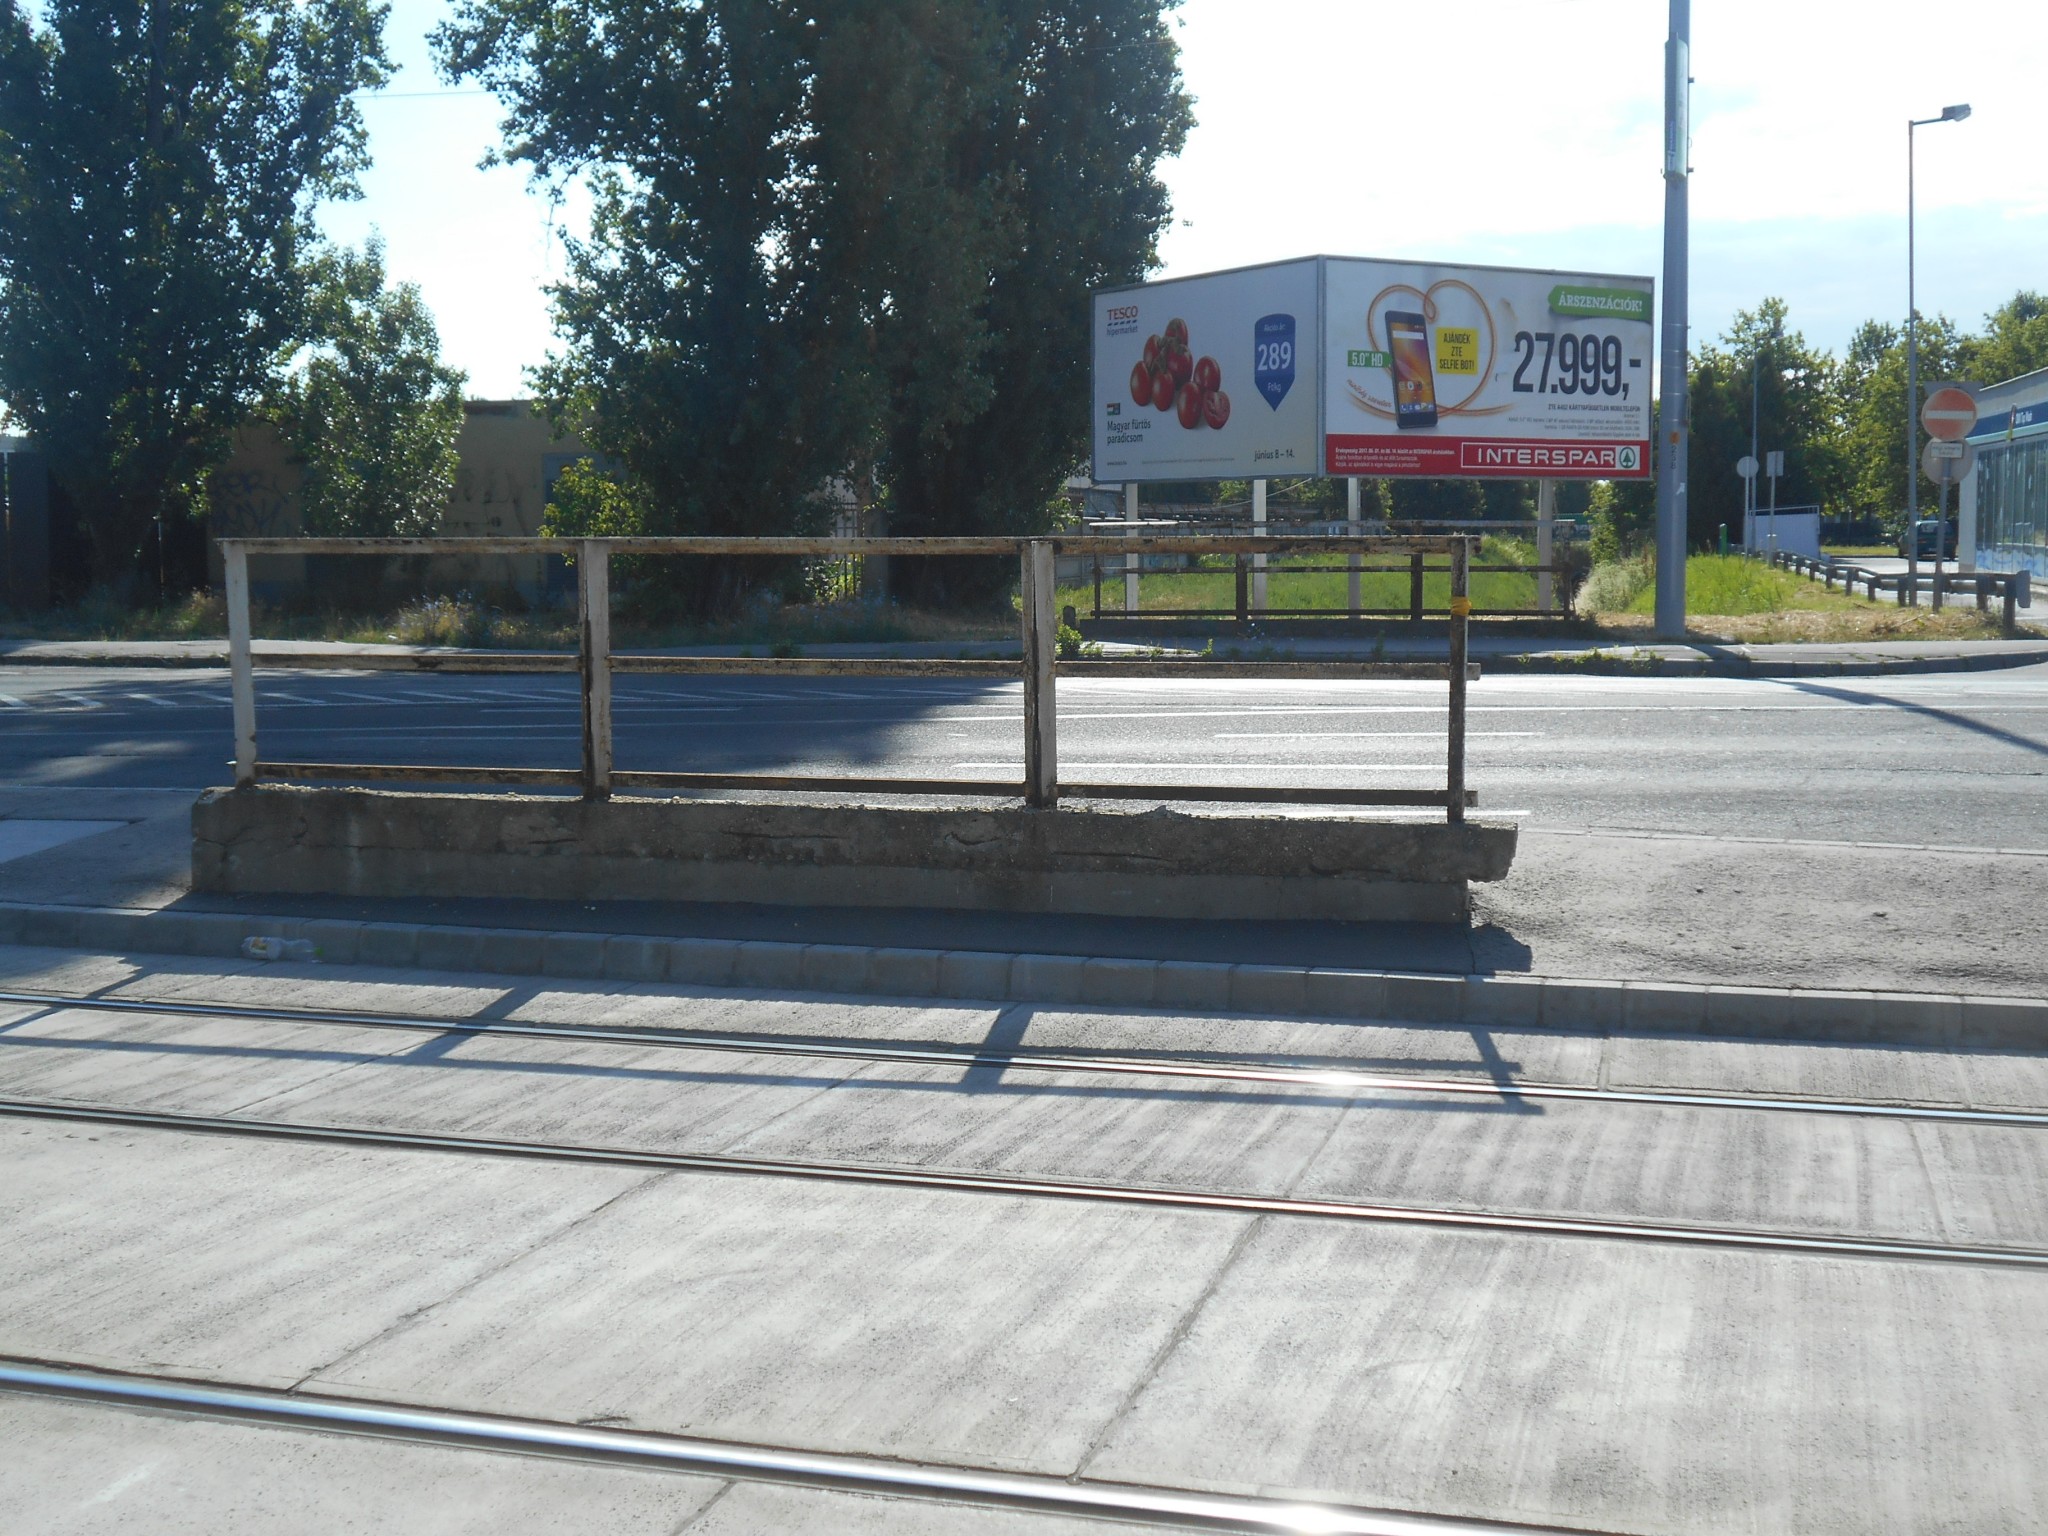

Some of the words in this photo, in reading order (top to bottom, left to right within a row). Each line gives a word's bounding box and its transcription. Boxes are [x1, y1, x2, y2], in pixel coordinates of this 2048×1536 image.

[1558, 291, 1643, 312] ÁRSZENZÁCIÓK!
[1107, 305, 1138, 320] TESCO
[1106, 325, 1138, 337] hipermarket
[1443, 331, 1471, 344] AJÁNDÉK
[1257, 341, 1292, 371] 289
[1450, 346, 1463, 357] ZTE
[1371, 353, 1383, 367] HD
[1439, 358, 1460, 370] SELFIE
[1460, 359, 1475, 371] BOT!
[1512, 330, 1642, 401] 27.999,-
[1107, 420, 1131, 433] Magyar
[1131, 418, 1151, 430] fürtös
[1107, 432, 1144, 446] paradicsom
[1254, 449, 1274, 462] június
[1274, 449, 1280, 459] 8
[1285, 448, 1295, 459] 14.
[1477, 447, 1615, 465] INTERSPAR
